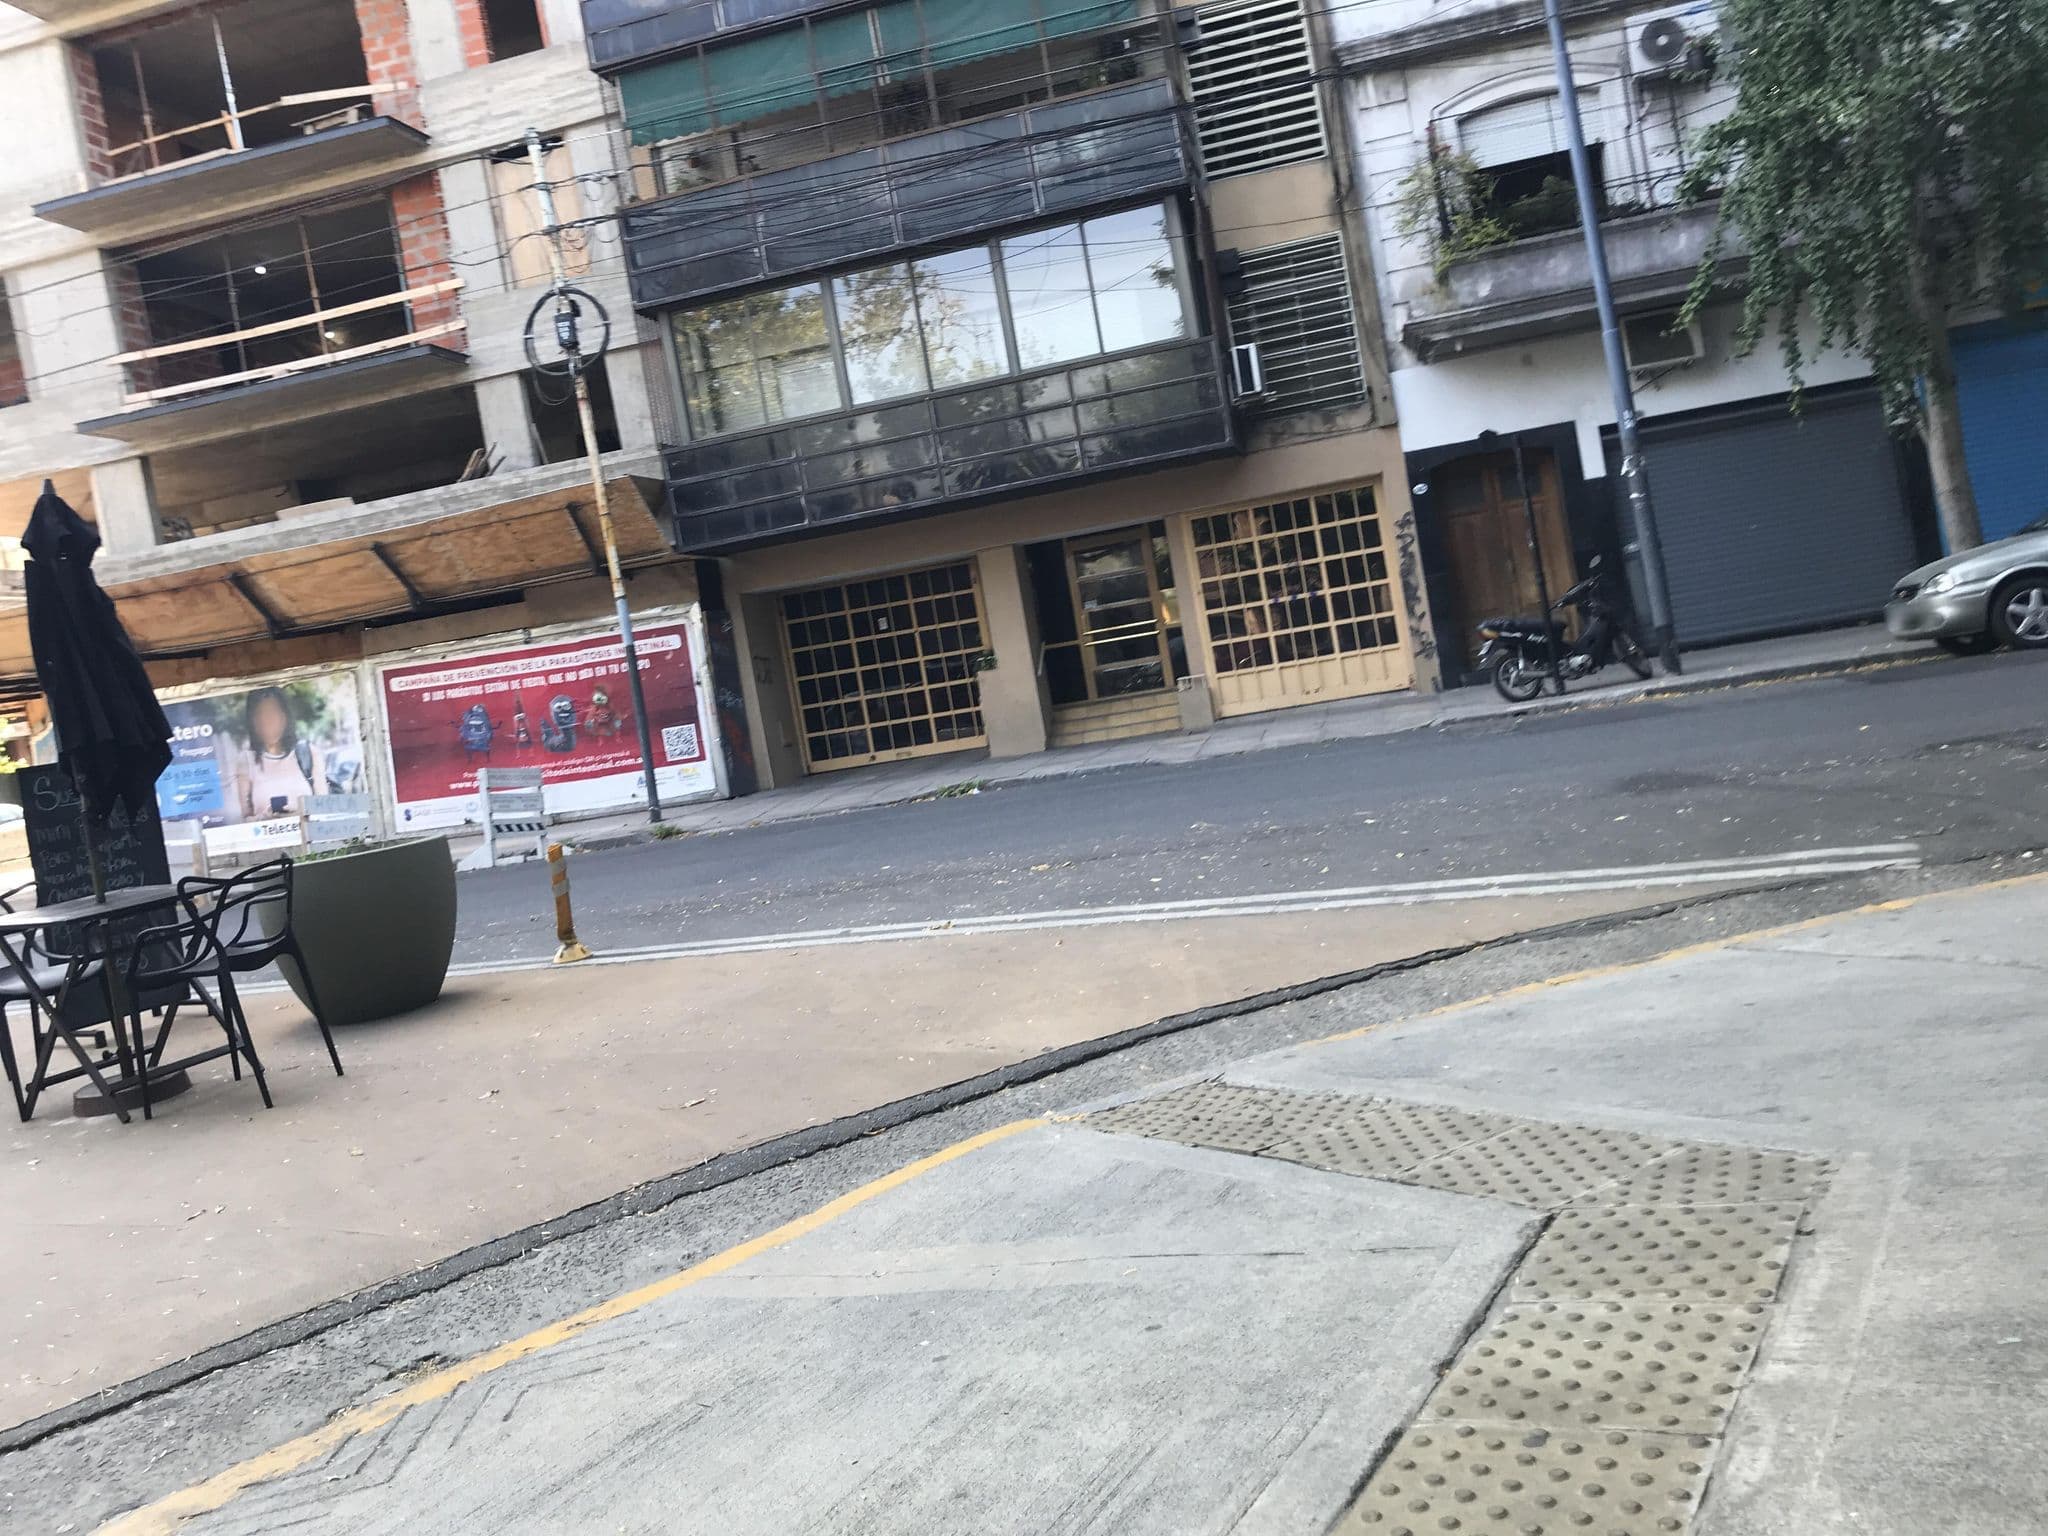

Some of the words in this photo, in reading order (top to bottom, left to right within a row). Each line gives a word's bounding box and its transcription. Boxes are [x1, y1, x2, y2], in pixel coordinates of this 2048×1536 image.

[398, 674, 441, 688] CAMPAÑA
[443, 673, 455, 682] DE
[521, 661, 532, 671] DE
[535, 659, 546, 668] LA
[550, 648, 611, 666] PARASITOSIS
[615, 639, 673, 656] INSTINAL
